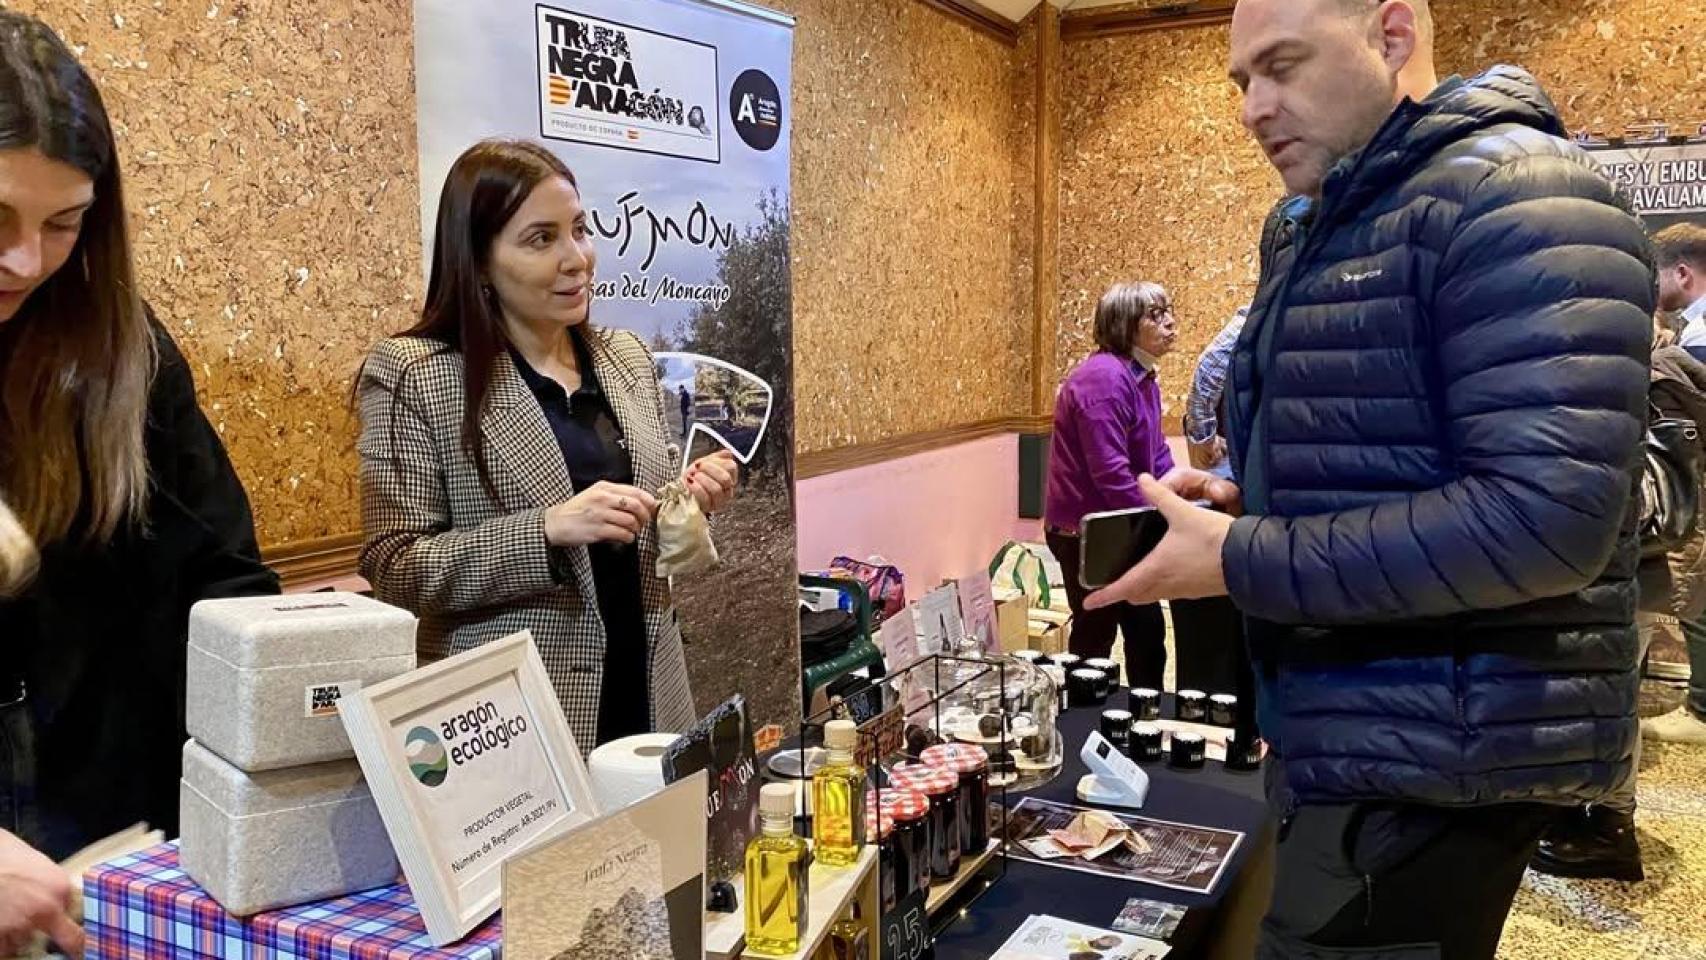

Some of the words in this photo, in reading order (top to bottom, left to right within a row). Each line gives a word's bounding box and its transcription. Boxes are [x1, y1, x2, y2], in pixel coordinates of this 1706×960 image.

[545, 14, 632, 60] TRUFA
[547, 45, 639, 90] NEGRA
[1642, 161, 1653, 185] Y
[584, 191, 732, 271] UFMON
[622, 274, 648, 298] del
[652, 277, 730, 310] Moncayo
[441, 701, 498, 740] aragón
[451, 714, 527, 766] ecológico
[464, 806, 506, 837] PRODUCTOR
[504, 790, 535, 813] VEGETAL
[451, 850, 482, 873] Número
[481, 841, 492, 855] de
